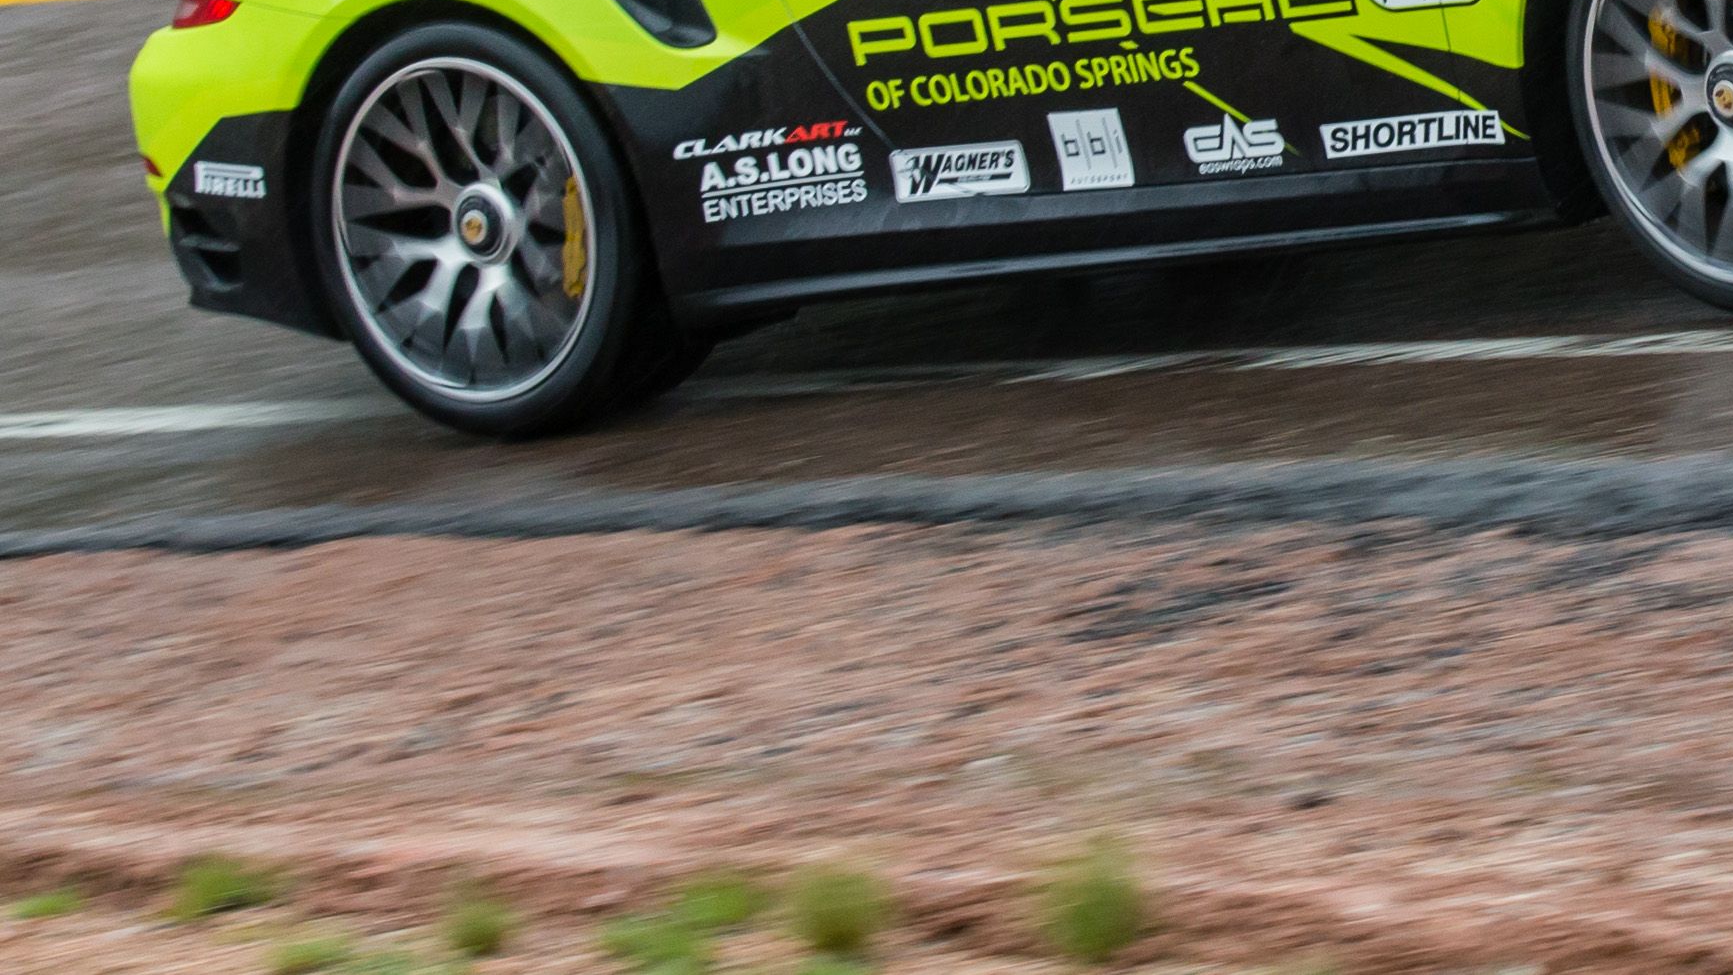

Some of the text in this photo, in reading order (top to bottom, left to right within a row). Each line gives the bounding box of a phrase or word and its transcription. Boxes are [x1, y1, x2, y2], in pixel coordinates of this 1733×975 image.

[865, 46, 1201, 111] OF COLORADO SPRINGS
[673, 120, 848, 161] CLARKART
[1330, 114, 1497, 153] SHORTLINE
[702, 178, 869, 224] ENTERPRISES
